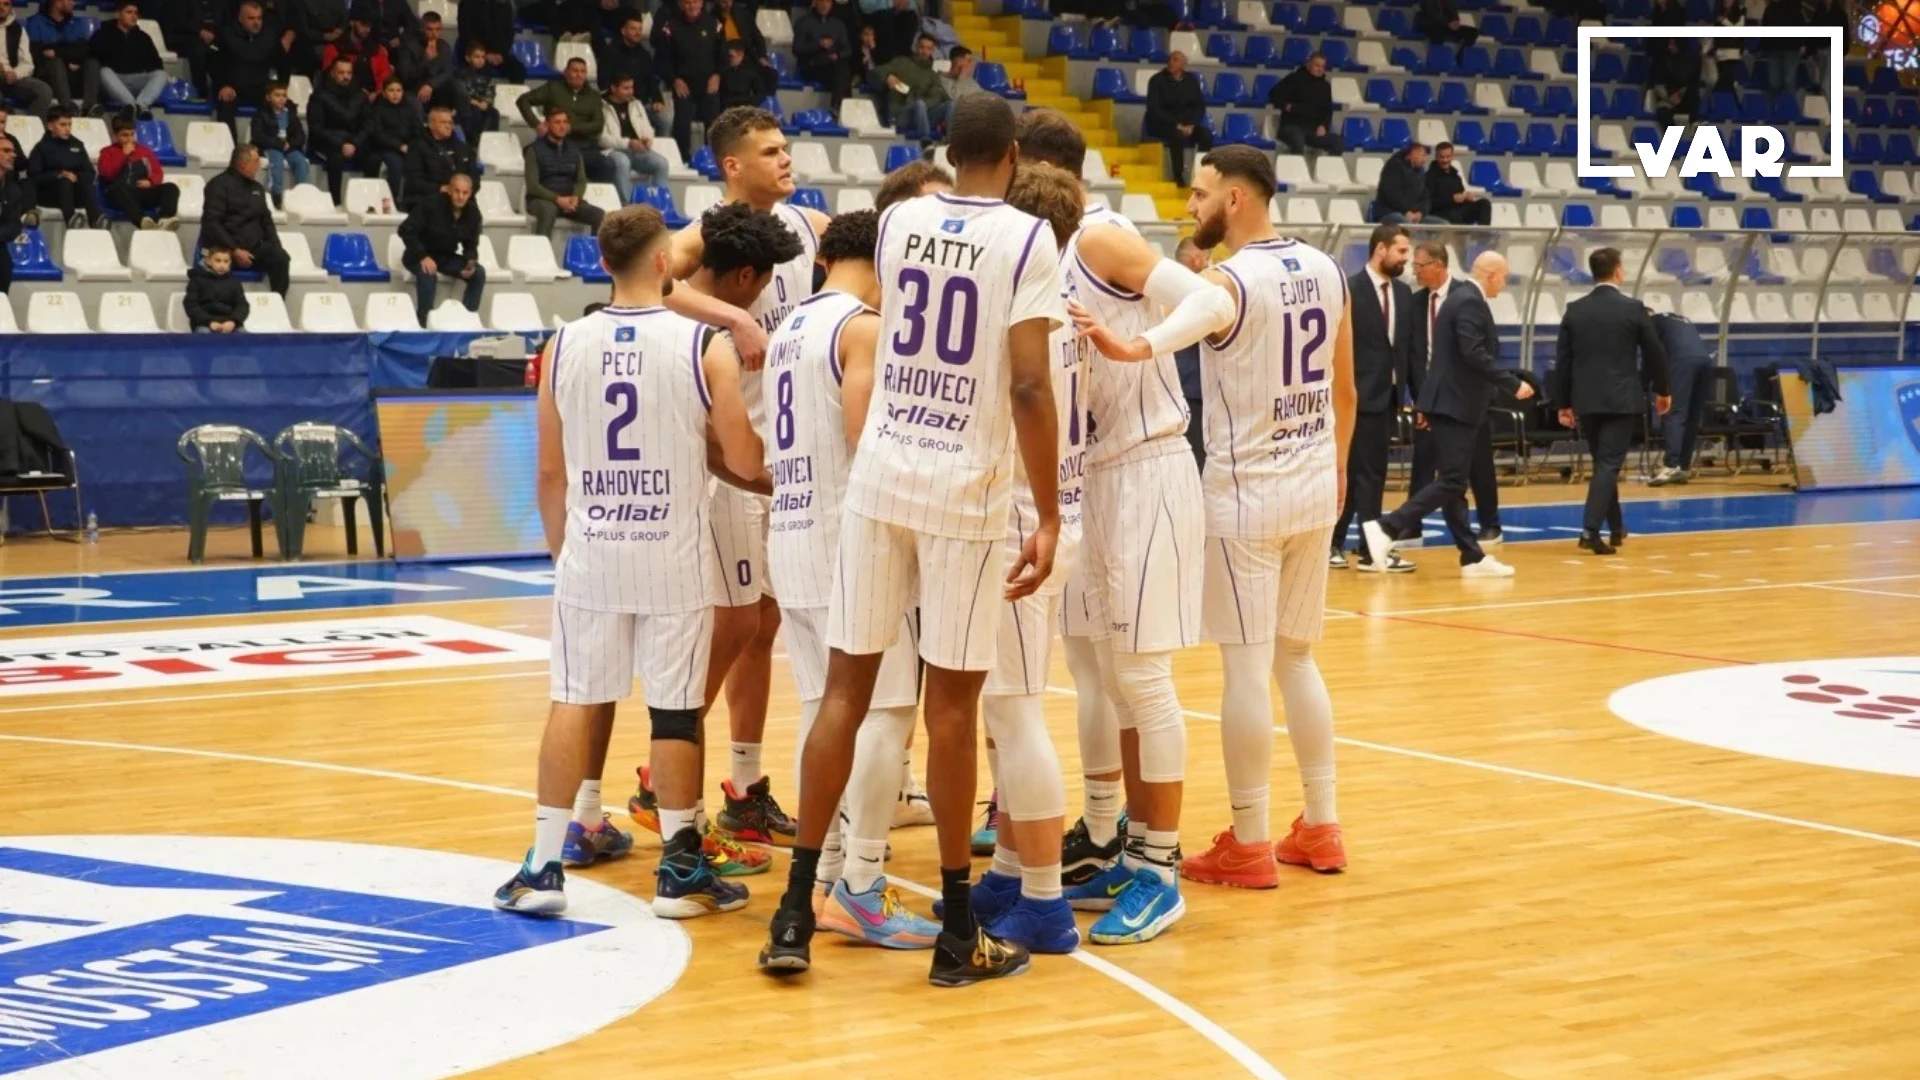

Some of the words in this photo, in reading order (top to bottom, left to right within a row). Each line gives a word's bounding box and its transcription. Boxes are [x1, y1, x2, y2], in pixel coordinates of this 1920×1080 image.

[904, 234, 984, 271] PATTY
[776, 275, 786, 303] 0
[1280, 278, 1320, 306] EJUPI
[893, 267, 978, 366] 30
[1283, 308, 1326, 386] 12
[602, 351, 642, 376] PECI
[605, 381, 640, 461] 2
[776, 370, 794, 450] 8
[918, 437, 964, 454] GROUP
[583, 469, 670, 496] RAHOVECI
[771, 456, 812, 488] HOVECI
[588, 503, 670, 521] Orllati
[771, 490, 813, 512] rllati
[630, 531, 670, 541] GROUP
[788, 519, 814, 531] GROUP
[738, 559, 751, 586] 0
[0, 649, 119, 663] TO
[0, 640, 511, 685] BIGI
[0, 926, 427, 1048] MUSISTEM
